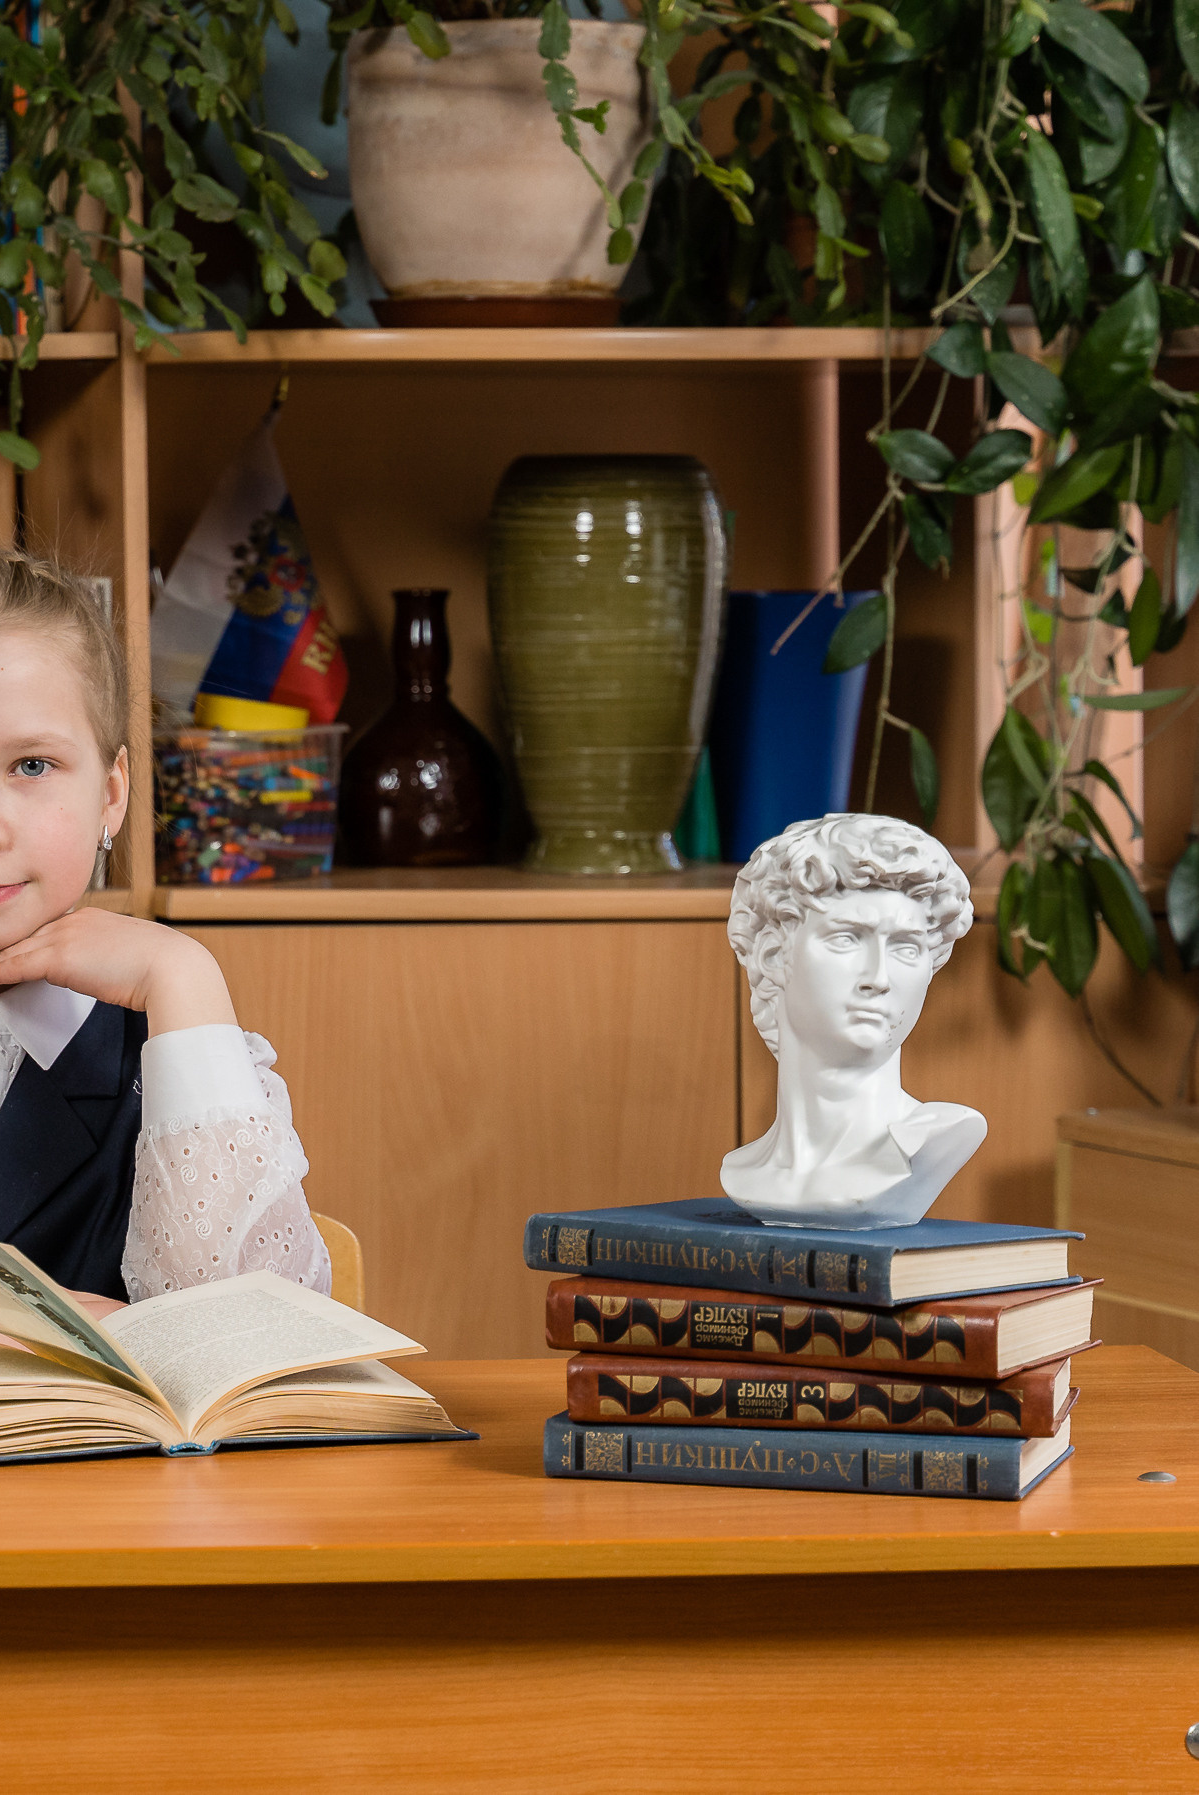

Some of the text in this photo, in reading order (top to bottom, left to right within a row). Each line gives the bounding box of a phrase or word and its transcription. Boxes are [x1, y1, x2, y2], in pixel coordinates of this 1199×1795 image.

[694, 1306, 748, 1324] КУПЕР
[695, 1322, 749, 1338] Фенимор
[696, 1333, 744, 1347] Джеймс
[737, 1382, 788, 1399] КУПЕР
[801, 1385, 825, 1399] 3
[738, 1397, 788, 1409] Фенимор
[739, 1407, 784, 1419] Джеймс
[634, 1440, 786, 1475] ПУШКИН
